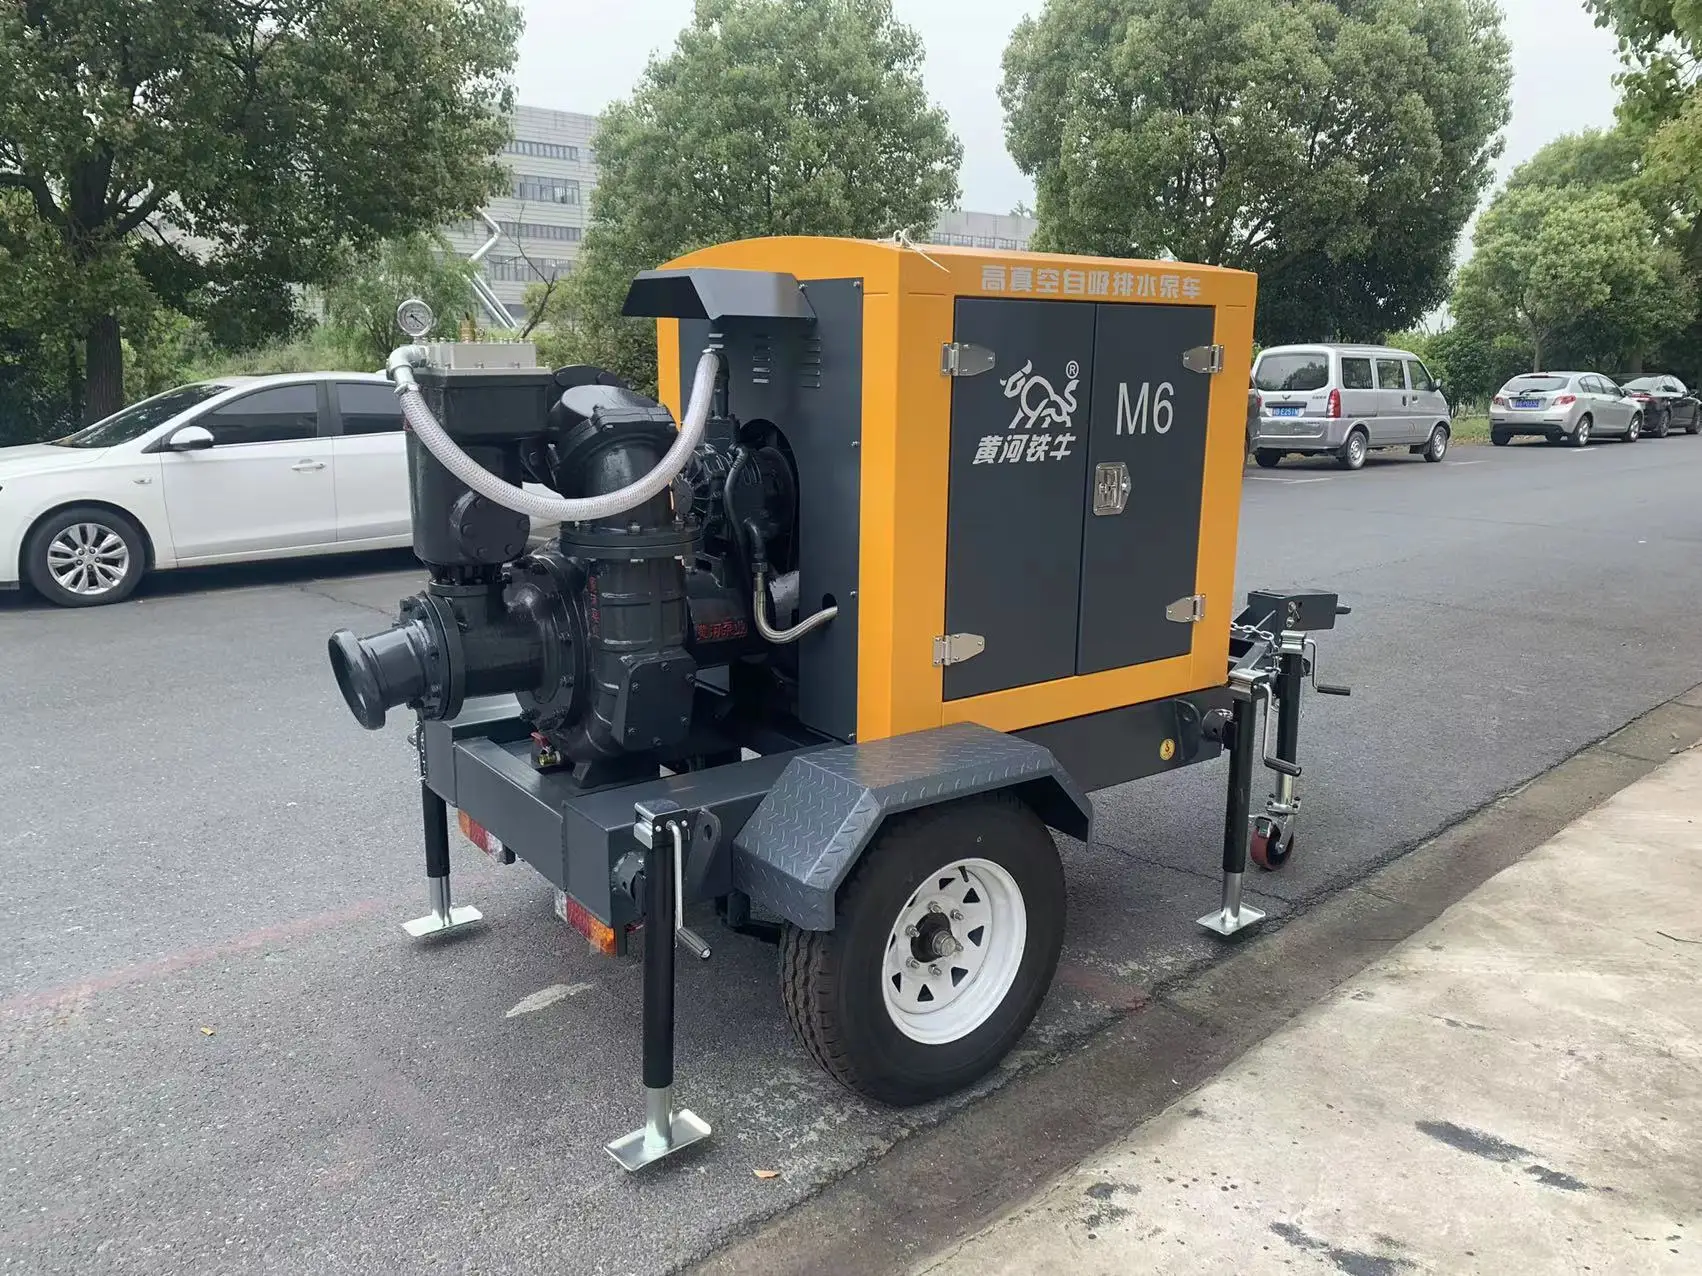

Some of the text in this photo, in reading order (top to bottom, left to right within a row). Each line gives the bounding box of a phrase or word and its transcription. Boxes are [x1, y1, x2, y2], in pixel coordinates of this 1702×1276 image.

[981, 265, 1201, 298] 高真空自吸排水泵车
[1116, 381, 1175, 435] M6
[972, 432, 1077, 465] 黄河铁牛
